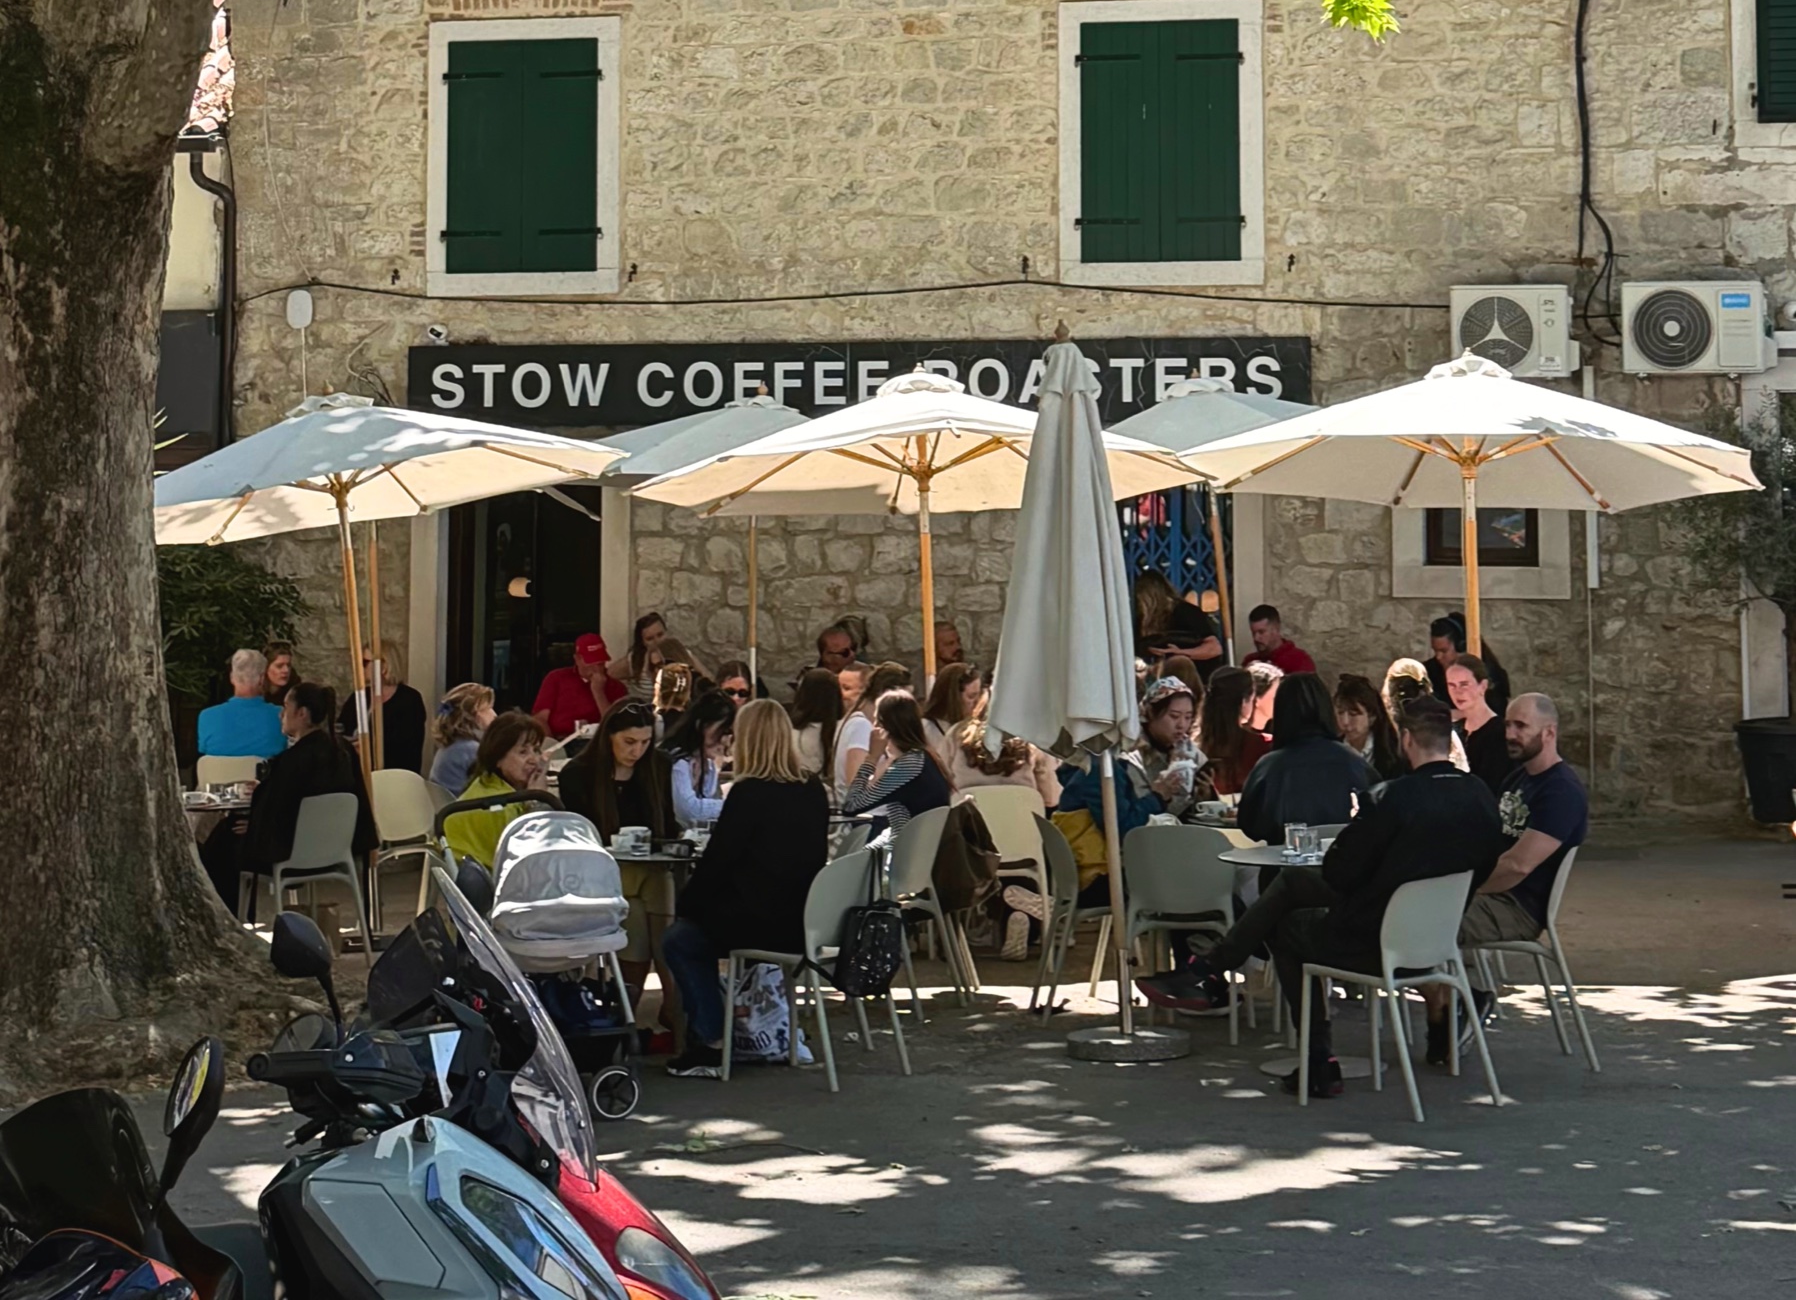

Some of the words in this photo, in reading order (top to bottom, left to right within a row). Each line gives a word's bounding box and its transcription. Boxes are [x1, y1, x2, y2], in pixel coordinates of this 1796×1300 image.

[431, 362, 610, 408] STOW
[637, 361, 889, 407] COFFEE
[922, 356, 1283, 403] OATERS
